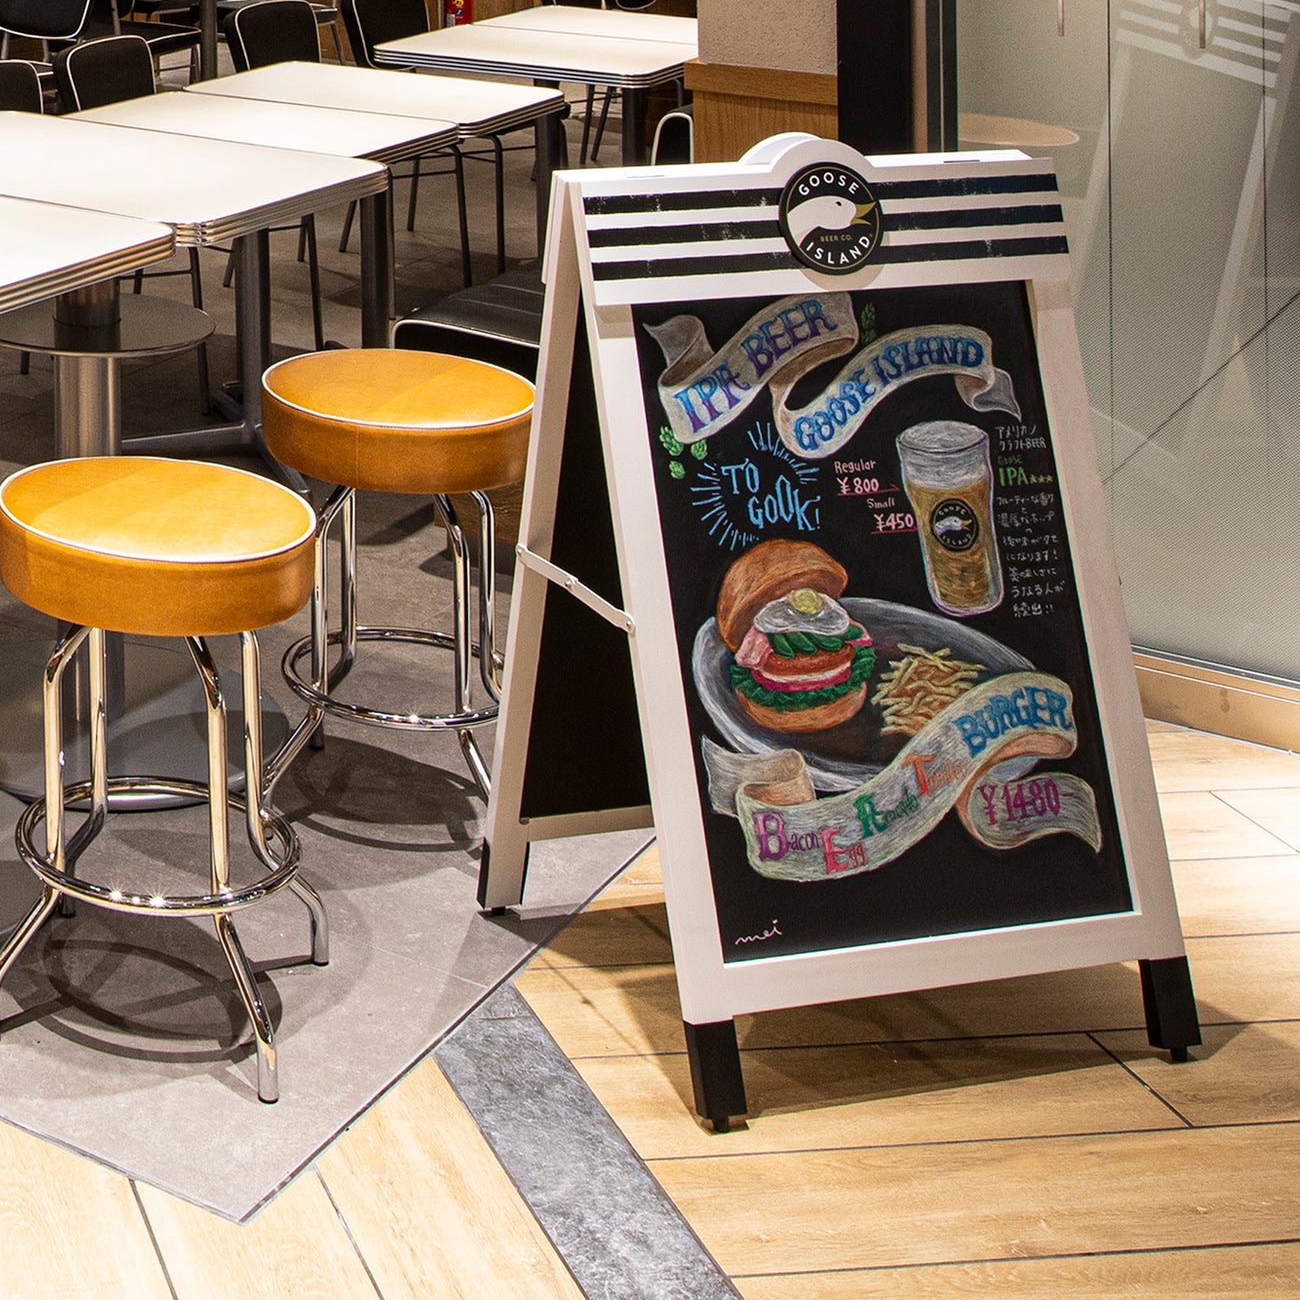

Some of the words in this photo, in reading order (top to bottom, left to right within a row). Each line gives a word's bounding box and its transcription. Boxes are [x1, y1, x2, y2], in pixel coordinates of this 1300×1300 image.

[798, 171, 860, 196] GOOSE
[805, 235, 871, 265] ISLAND
[674, 359, 753, 434] IPA
[741, 299, 838, 380] BEER
[794, 367, 877, 451] GOOSE
[871, 336, 984, 388] ISLAND
[721, 458, 760, 495] TO
[834, 459, 877, 475] Regular
[866, 498, 896, 509] Small
[752, 811, 820, 861] Bacon
[818, 826, 868, 875] Egg
[952, 685, 1074, 758] BURGER
